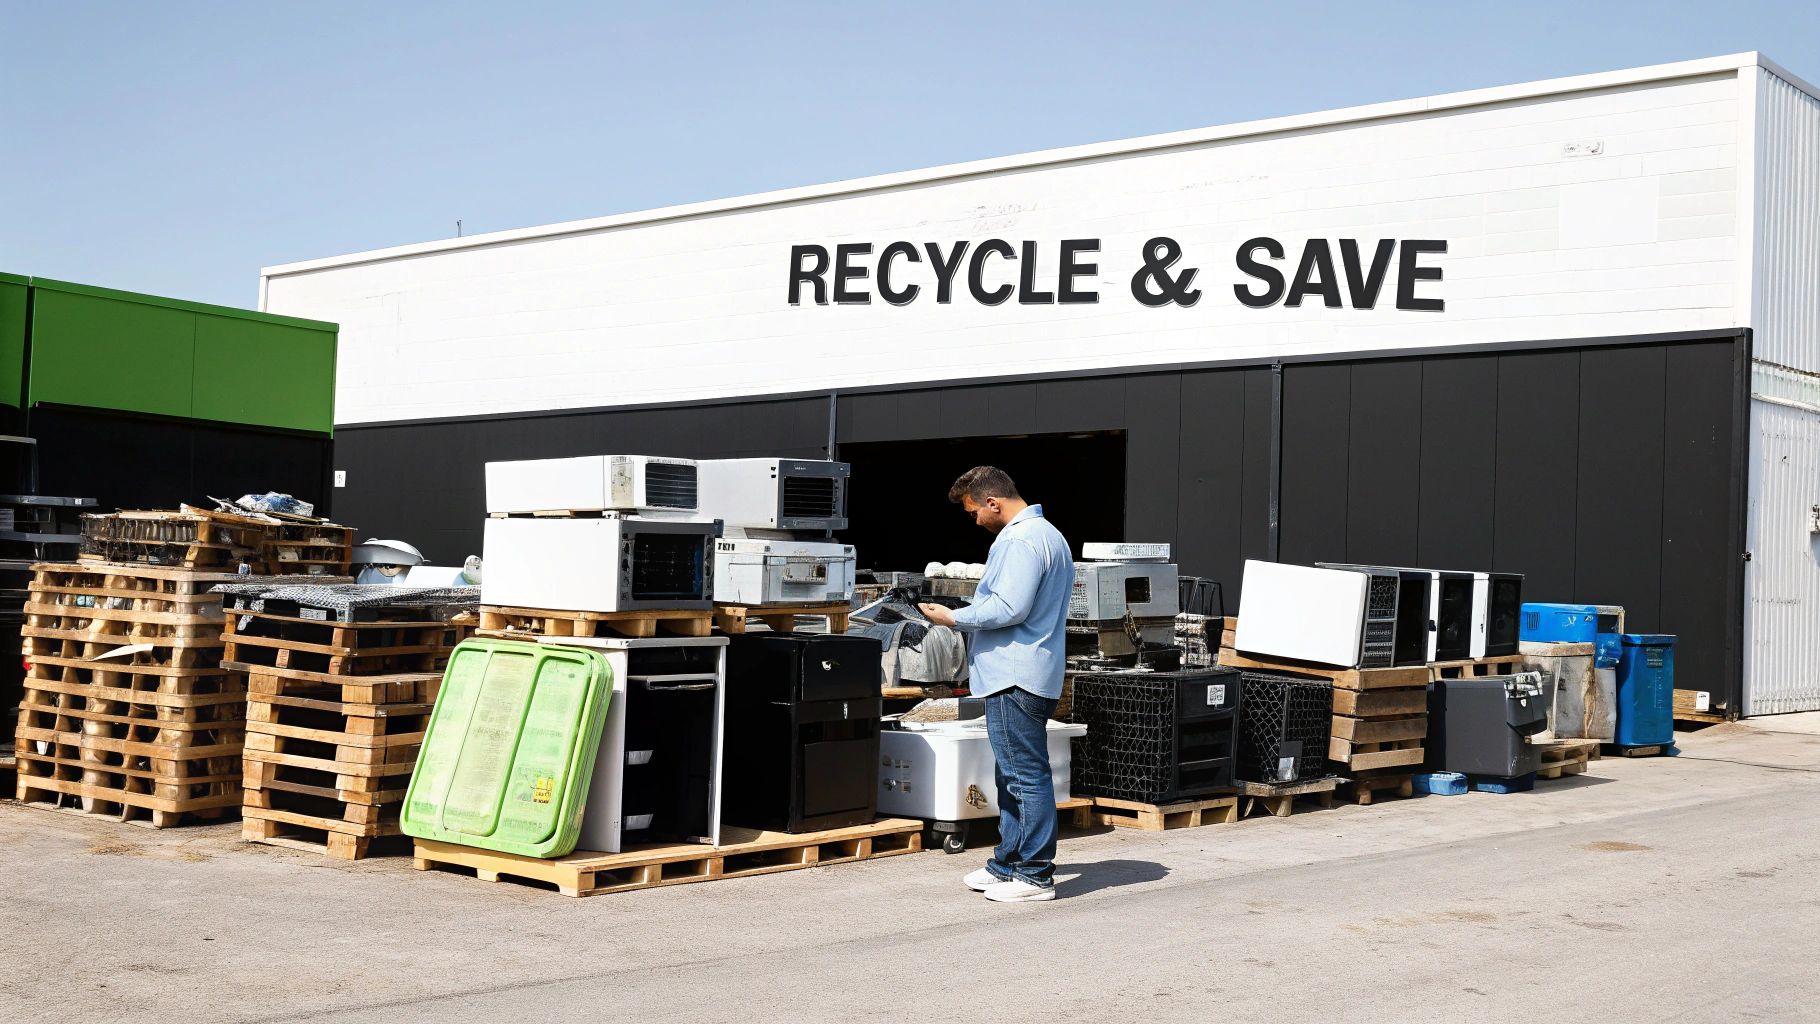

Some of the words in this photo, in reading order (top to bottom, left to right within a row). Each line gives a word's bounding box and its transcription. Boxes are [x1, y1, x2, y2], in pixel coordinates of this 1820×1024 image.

[788, 239, 1100, 307] RECYCLE
[1131, 237, 1203, 308] &
[1234, 237, 1448, 313] SAVE
